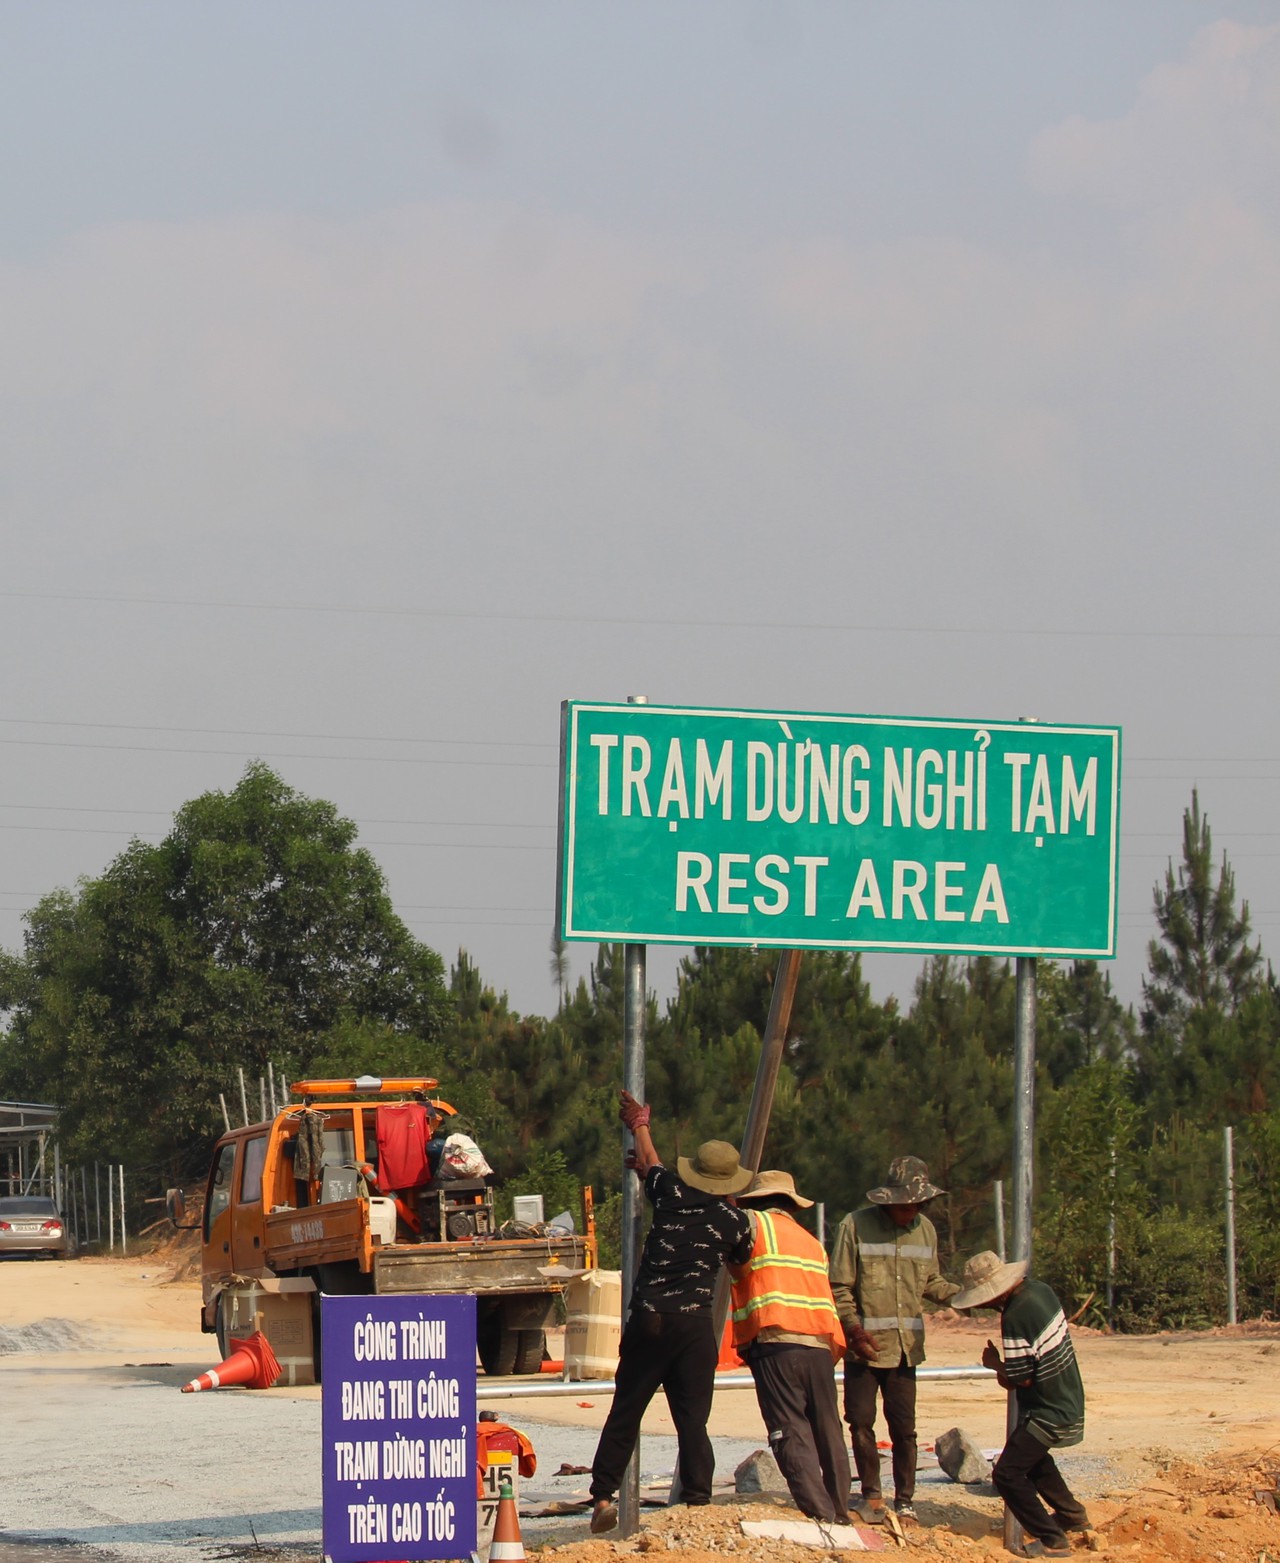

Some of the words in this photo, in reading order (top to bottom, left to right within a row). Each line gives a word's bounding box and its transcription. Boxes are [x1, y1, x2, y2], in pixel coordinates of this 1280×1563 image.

[589, 733, 734, 833] TRẠM
[746, 720, 871, 826] DỪNG
[882, 729, 992, 831] NGHỈ
[1003, 752, 1098, 848] TẠM
[675, 851, 829, 917] REST
[845, 858, 1010, 924] AREA
[354, 1312, 397, 1362] CÔNG
[400, 1311, 447, 1361] TRÌNH
[341, 1380, 385, 1421] ĐANG
[388, 1379, 413, 1420] THI
[417, 1370, 460, 1420] CÔNG
[334, 1440, 379, 1490] TRẠM
[383, 1431, 426, 1481] DỪNG
[429, 1424, 467, 1479] NGHỈ
[347, 1495, 388, 1544] TRÊN
[391, 1501, 422, 1543] CAO
[425, 1487, 456, 1542] TỐC
